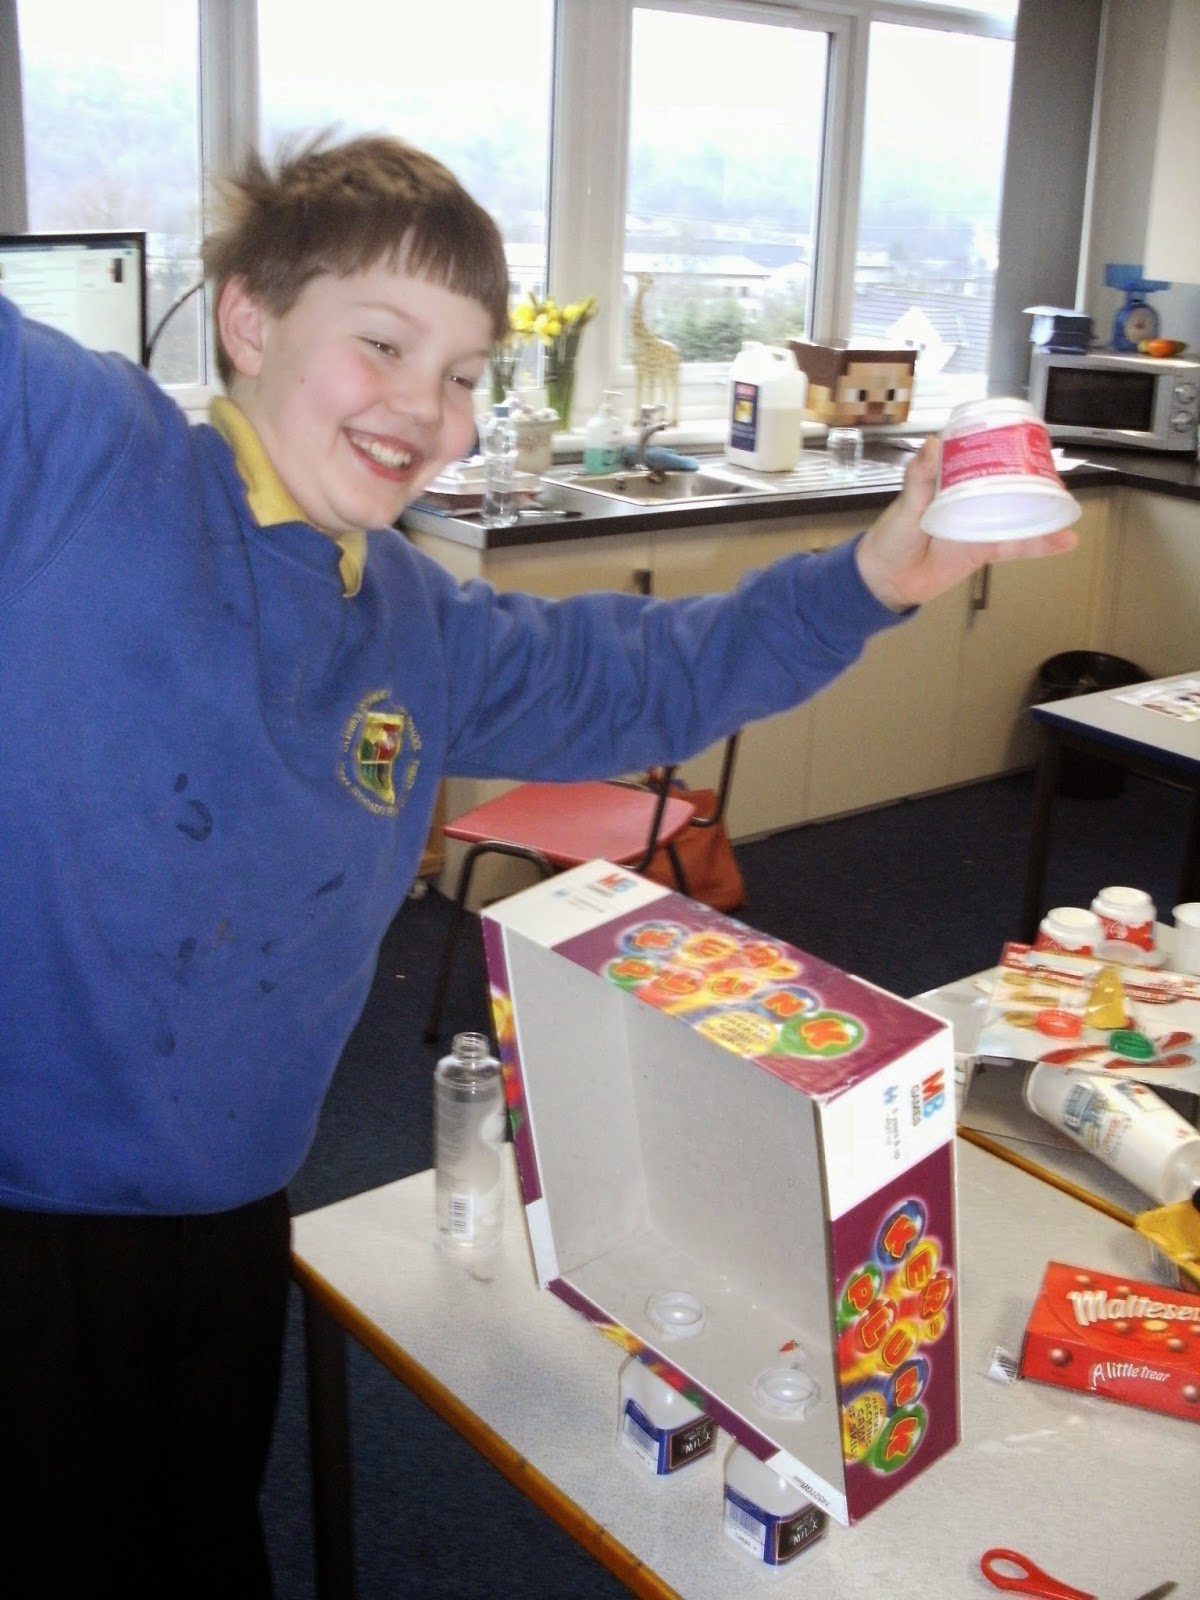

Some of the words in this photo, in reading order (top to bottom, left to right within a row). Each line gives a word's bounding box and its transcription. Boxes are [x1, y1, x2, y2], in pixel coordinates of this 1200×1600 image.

[911, 1084, 922, 1127] GAMES
[922, 1068, 945, 1119] MB
[685, 1431, 712, 1454] MILK
[793, 1519, 819, 1546] MILK
